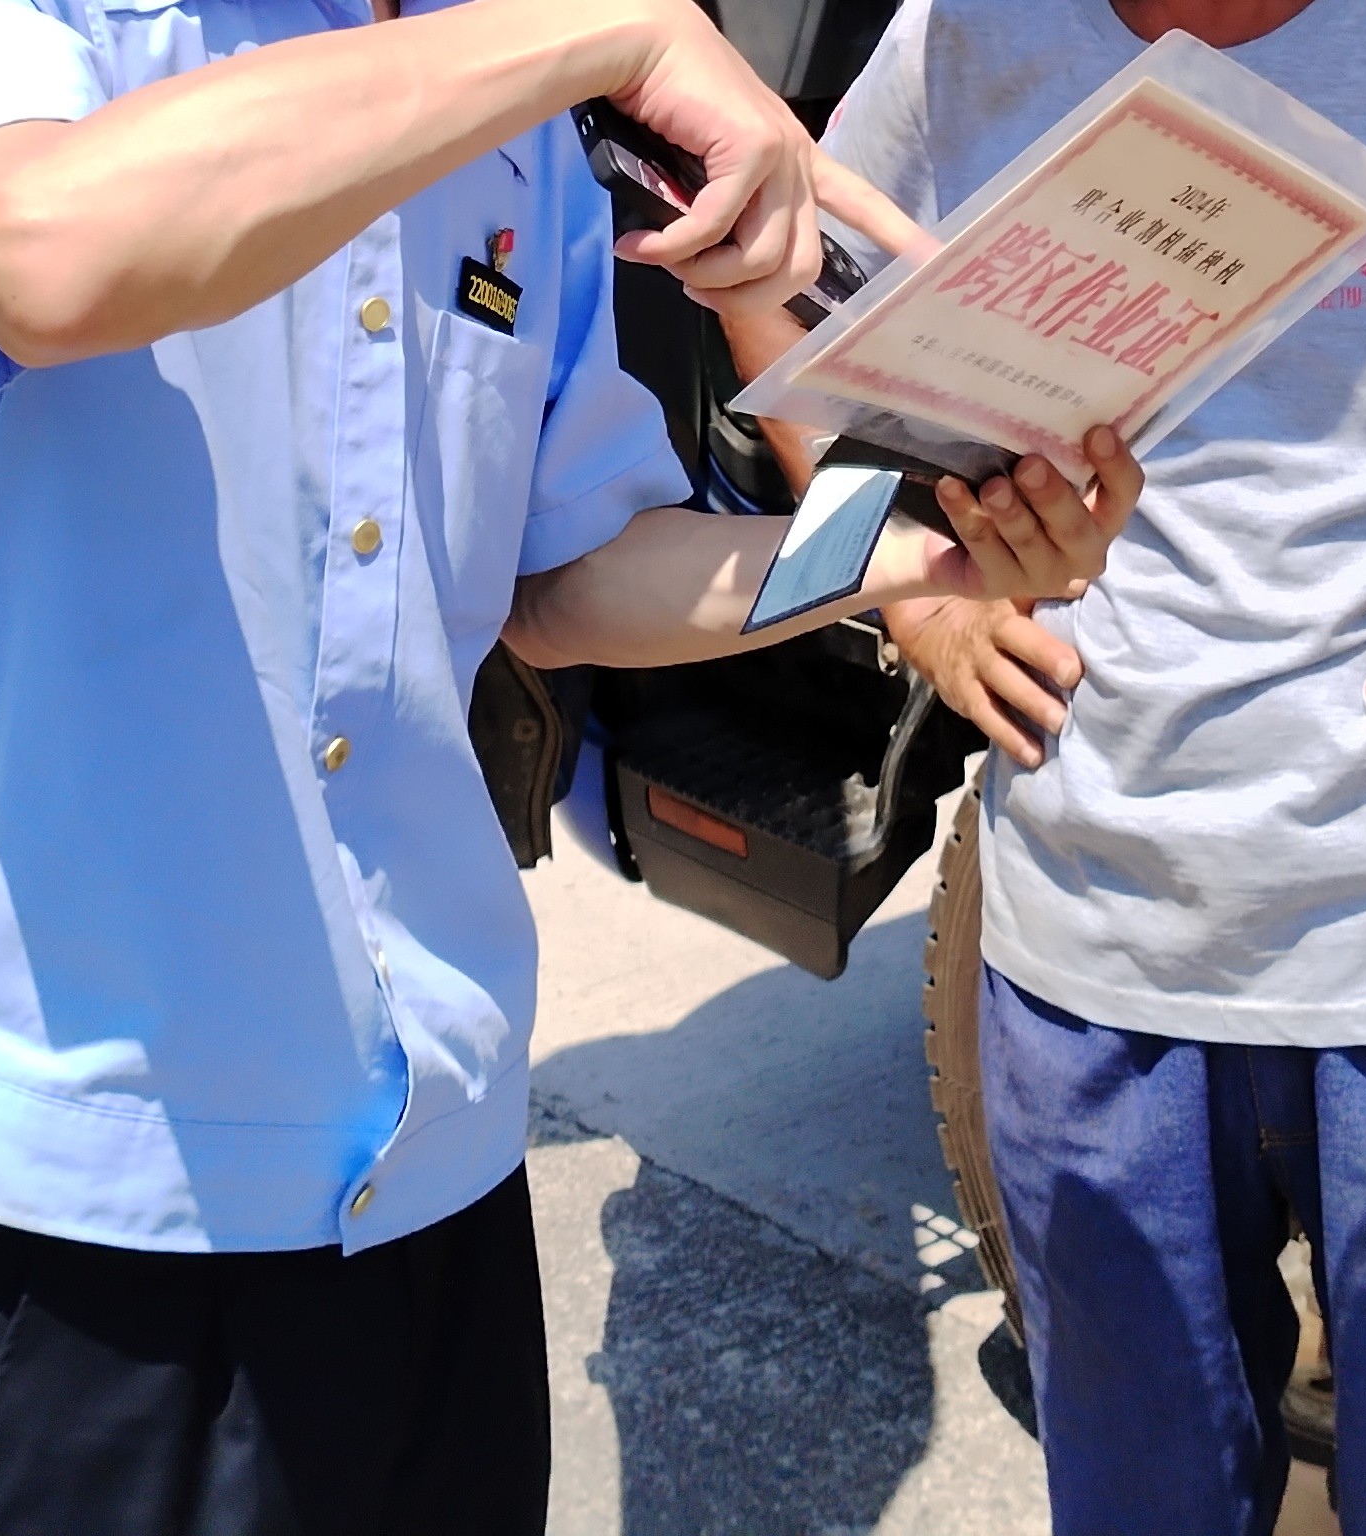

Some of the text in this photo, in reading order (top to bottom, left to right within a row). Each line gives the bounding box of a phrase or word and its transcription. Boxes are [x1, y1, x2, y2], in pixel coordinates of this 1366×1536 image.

[1071, 188, 1246, 286] 联合收割机插秧机
[1169, 184, 1233, 223] 2024年
[934, 221, 1220, 377] 跨区作业证
